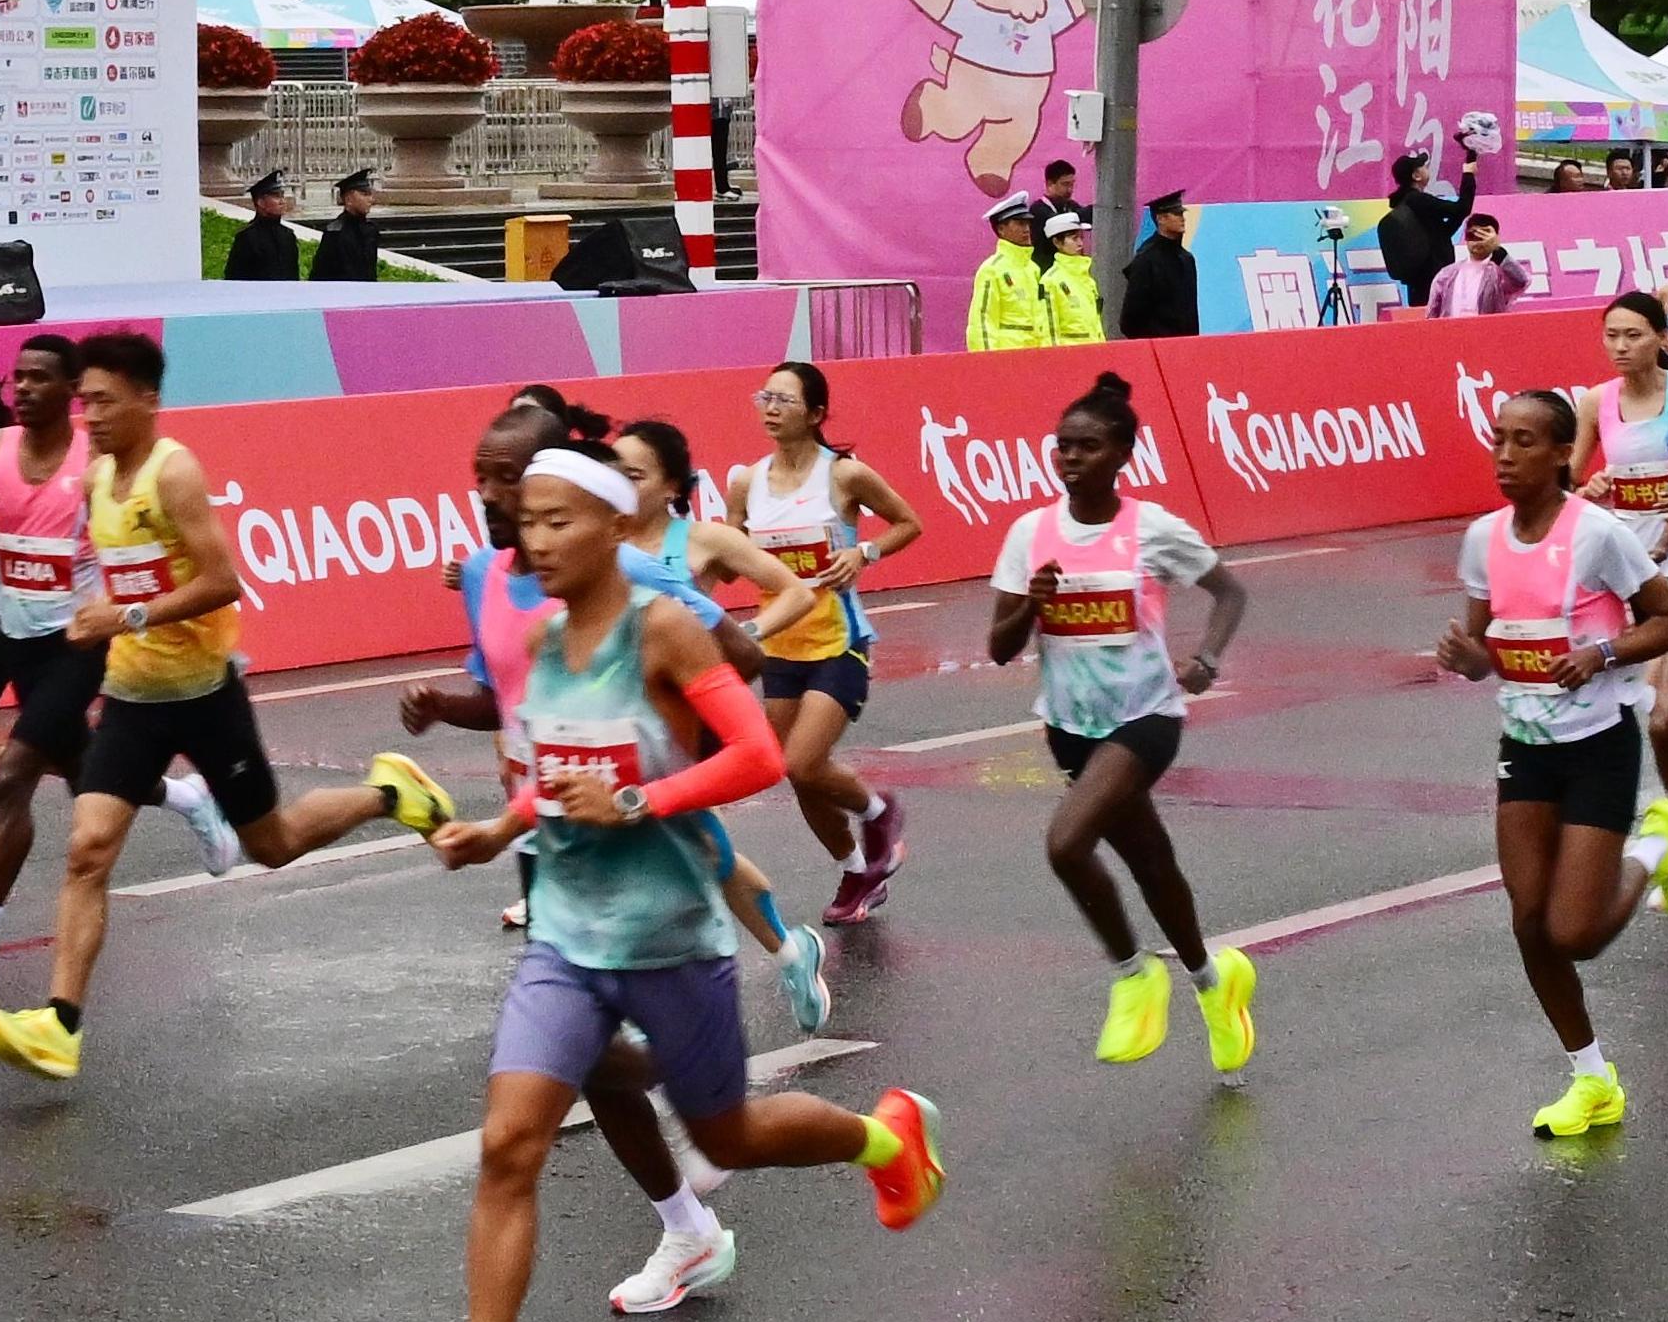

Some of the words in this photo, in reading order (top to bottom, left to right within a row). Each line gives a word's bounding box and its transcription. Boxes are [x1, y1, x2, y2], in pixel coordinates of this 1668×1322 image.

[1248, 401, 1427, 472] QIAODAN
[5, 559, 57, 582] LEMA
[238, 496, 486, 585] QIAODA
